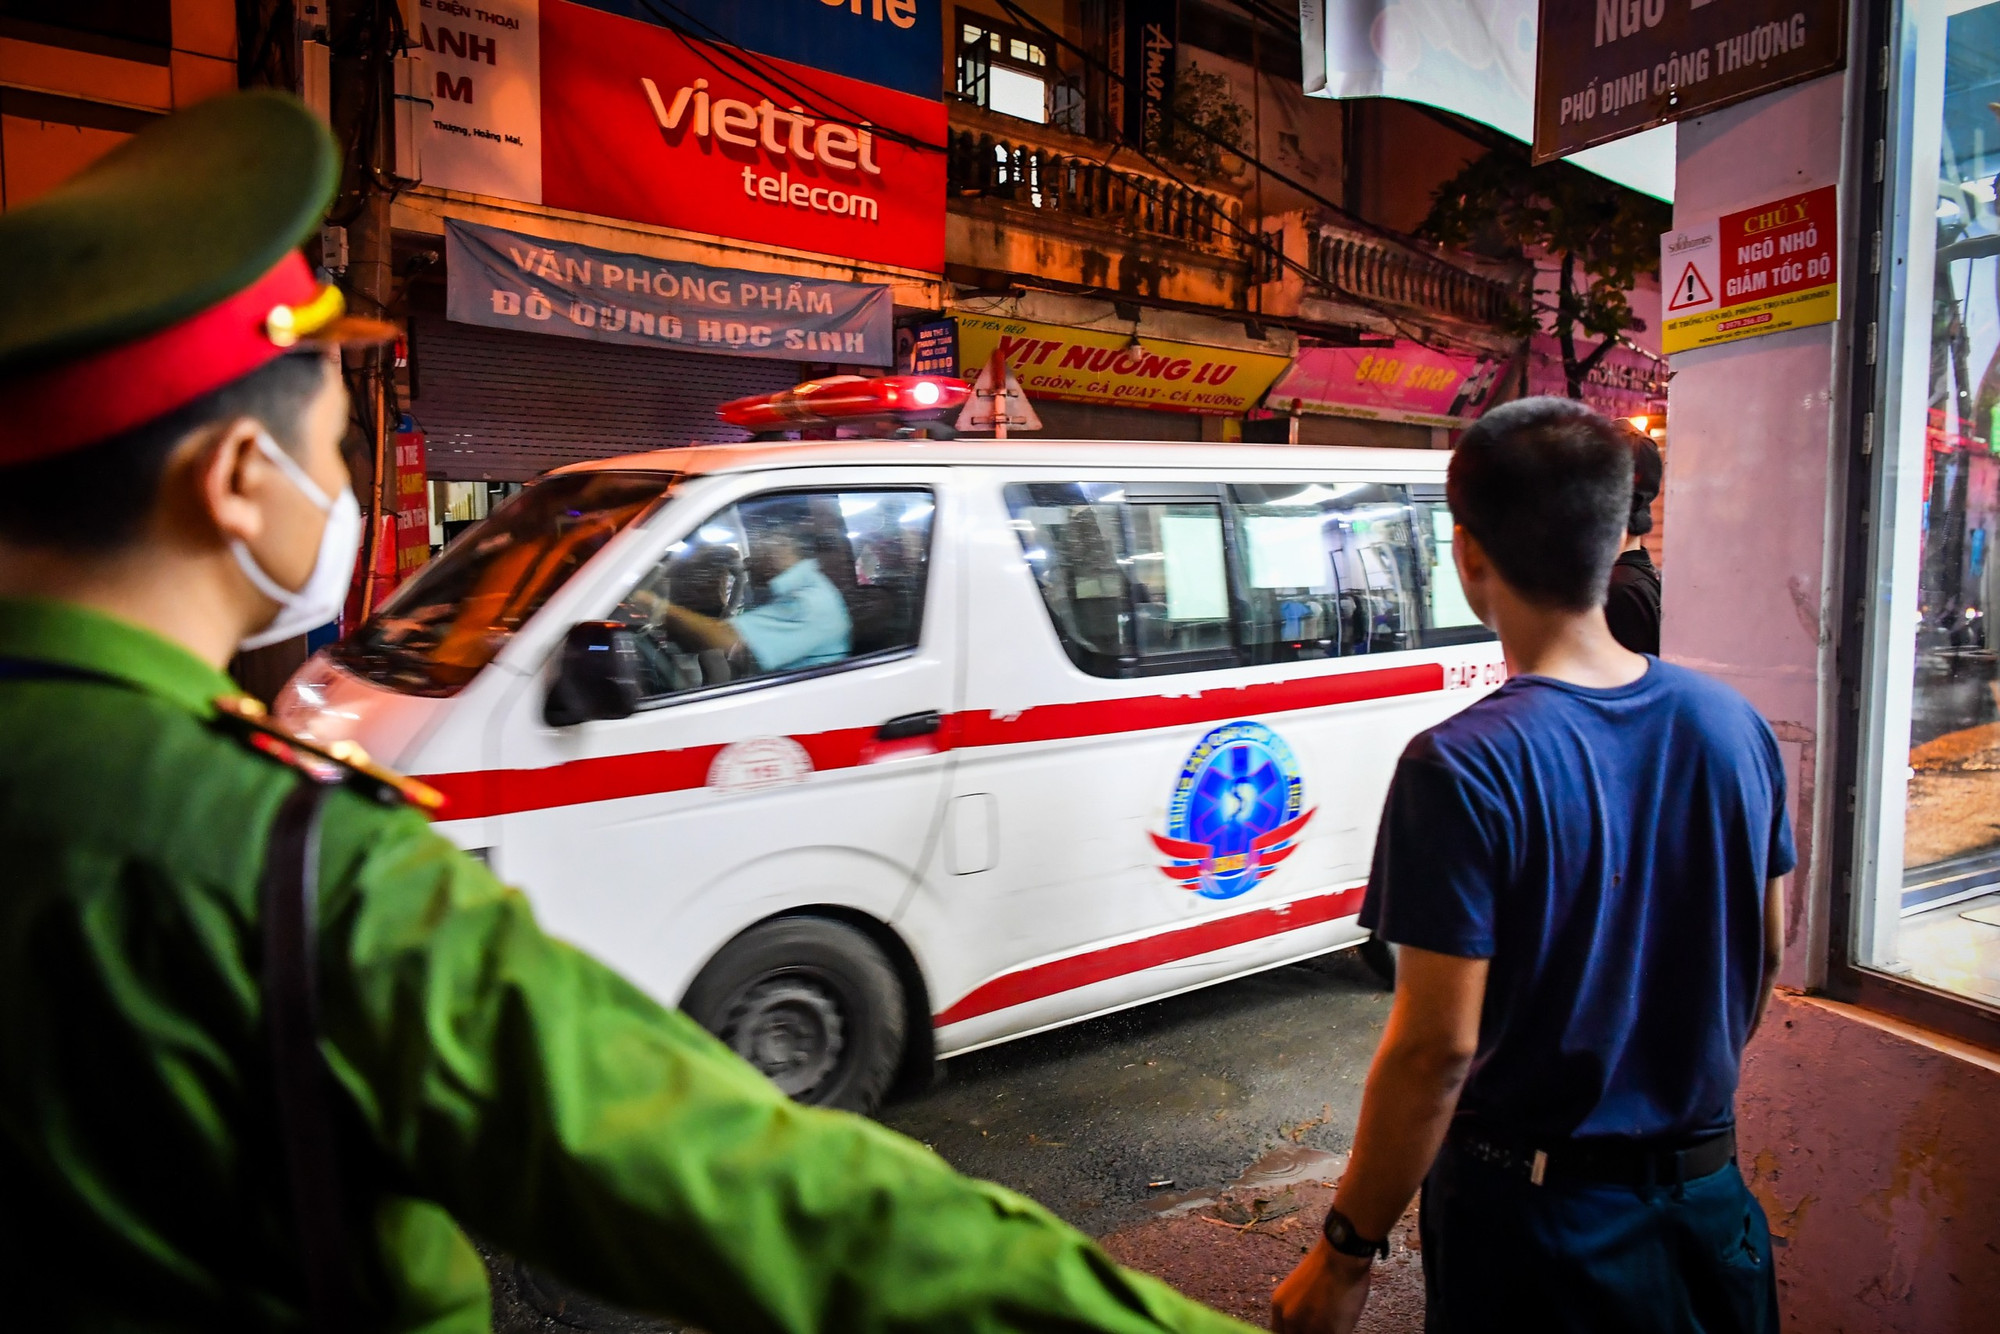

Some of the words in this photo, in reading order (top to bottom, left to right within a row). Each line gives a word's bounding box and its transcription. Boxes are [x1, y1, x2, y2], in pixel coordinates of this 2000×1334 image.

[475, 9, 520, 30] THOẠI
[1560, 76, 1598, 125] PHỐ
[1601, 69, 1648, 116] ĐỊNH
[1653, 51, 1710, 96] CÔNG
[1715, 12, 1806, 75] THƯỢNG
[741, 166, 878, 220] telecom
[1744, 203, 1789, 233] CHÚ
[1794, 197, 1809, 219] Ý
[1737, 237, 1775, 265] NGÕ
[1779, 222, 1818, 255] NHỎ
[509, 247, 592, 285] VĂN
[603, 264, 733, 305] PHÒNG
[741, 281, 833, 315] PHẨM
[1726, 268, 1768, 297] GIẢM
[1771, 258, 1803, 287] TỐC
[1807, 252, 1831, 280] ĐỘ
[491, 287, 552, 321] ĐỒ
[570, 301, 682, 339] DÙNG
[699, 319, 772, 350] HỌC
[784, 327, 865, 353] SINH
[999, 335, 1064, 369] VỊT
[1191, 362, 1238, 386] LU
[1405, 363, 1458, 391] SHOP
[1112, 384, 1161, 398] QUAY
